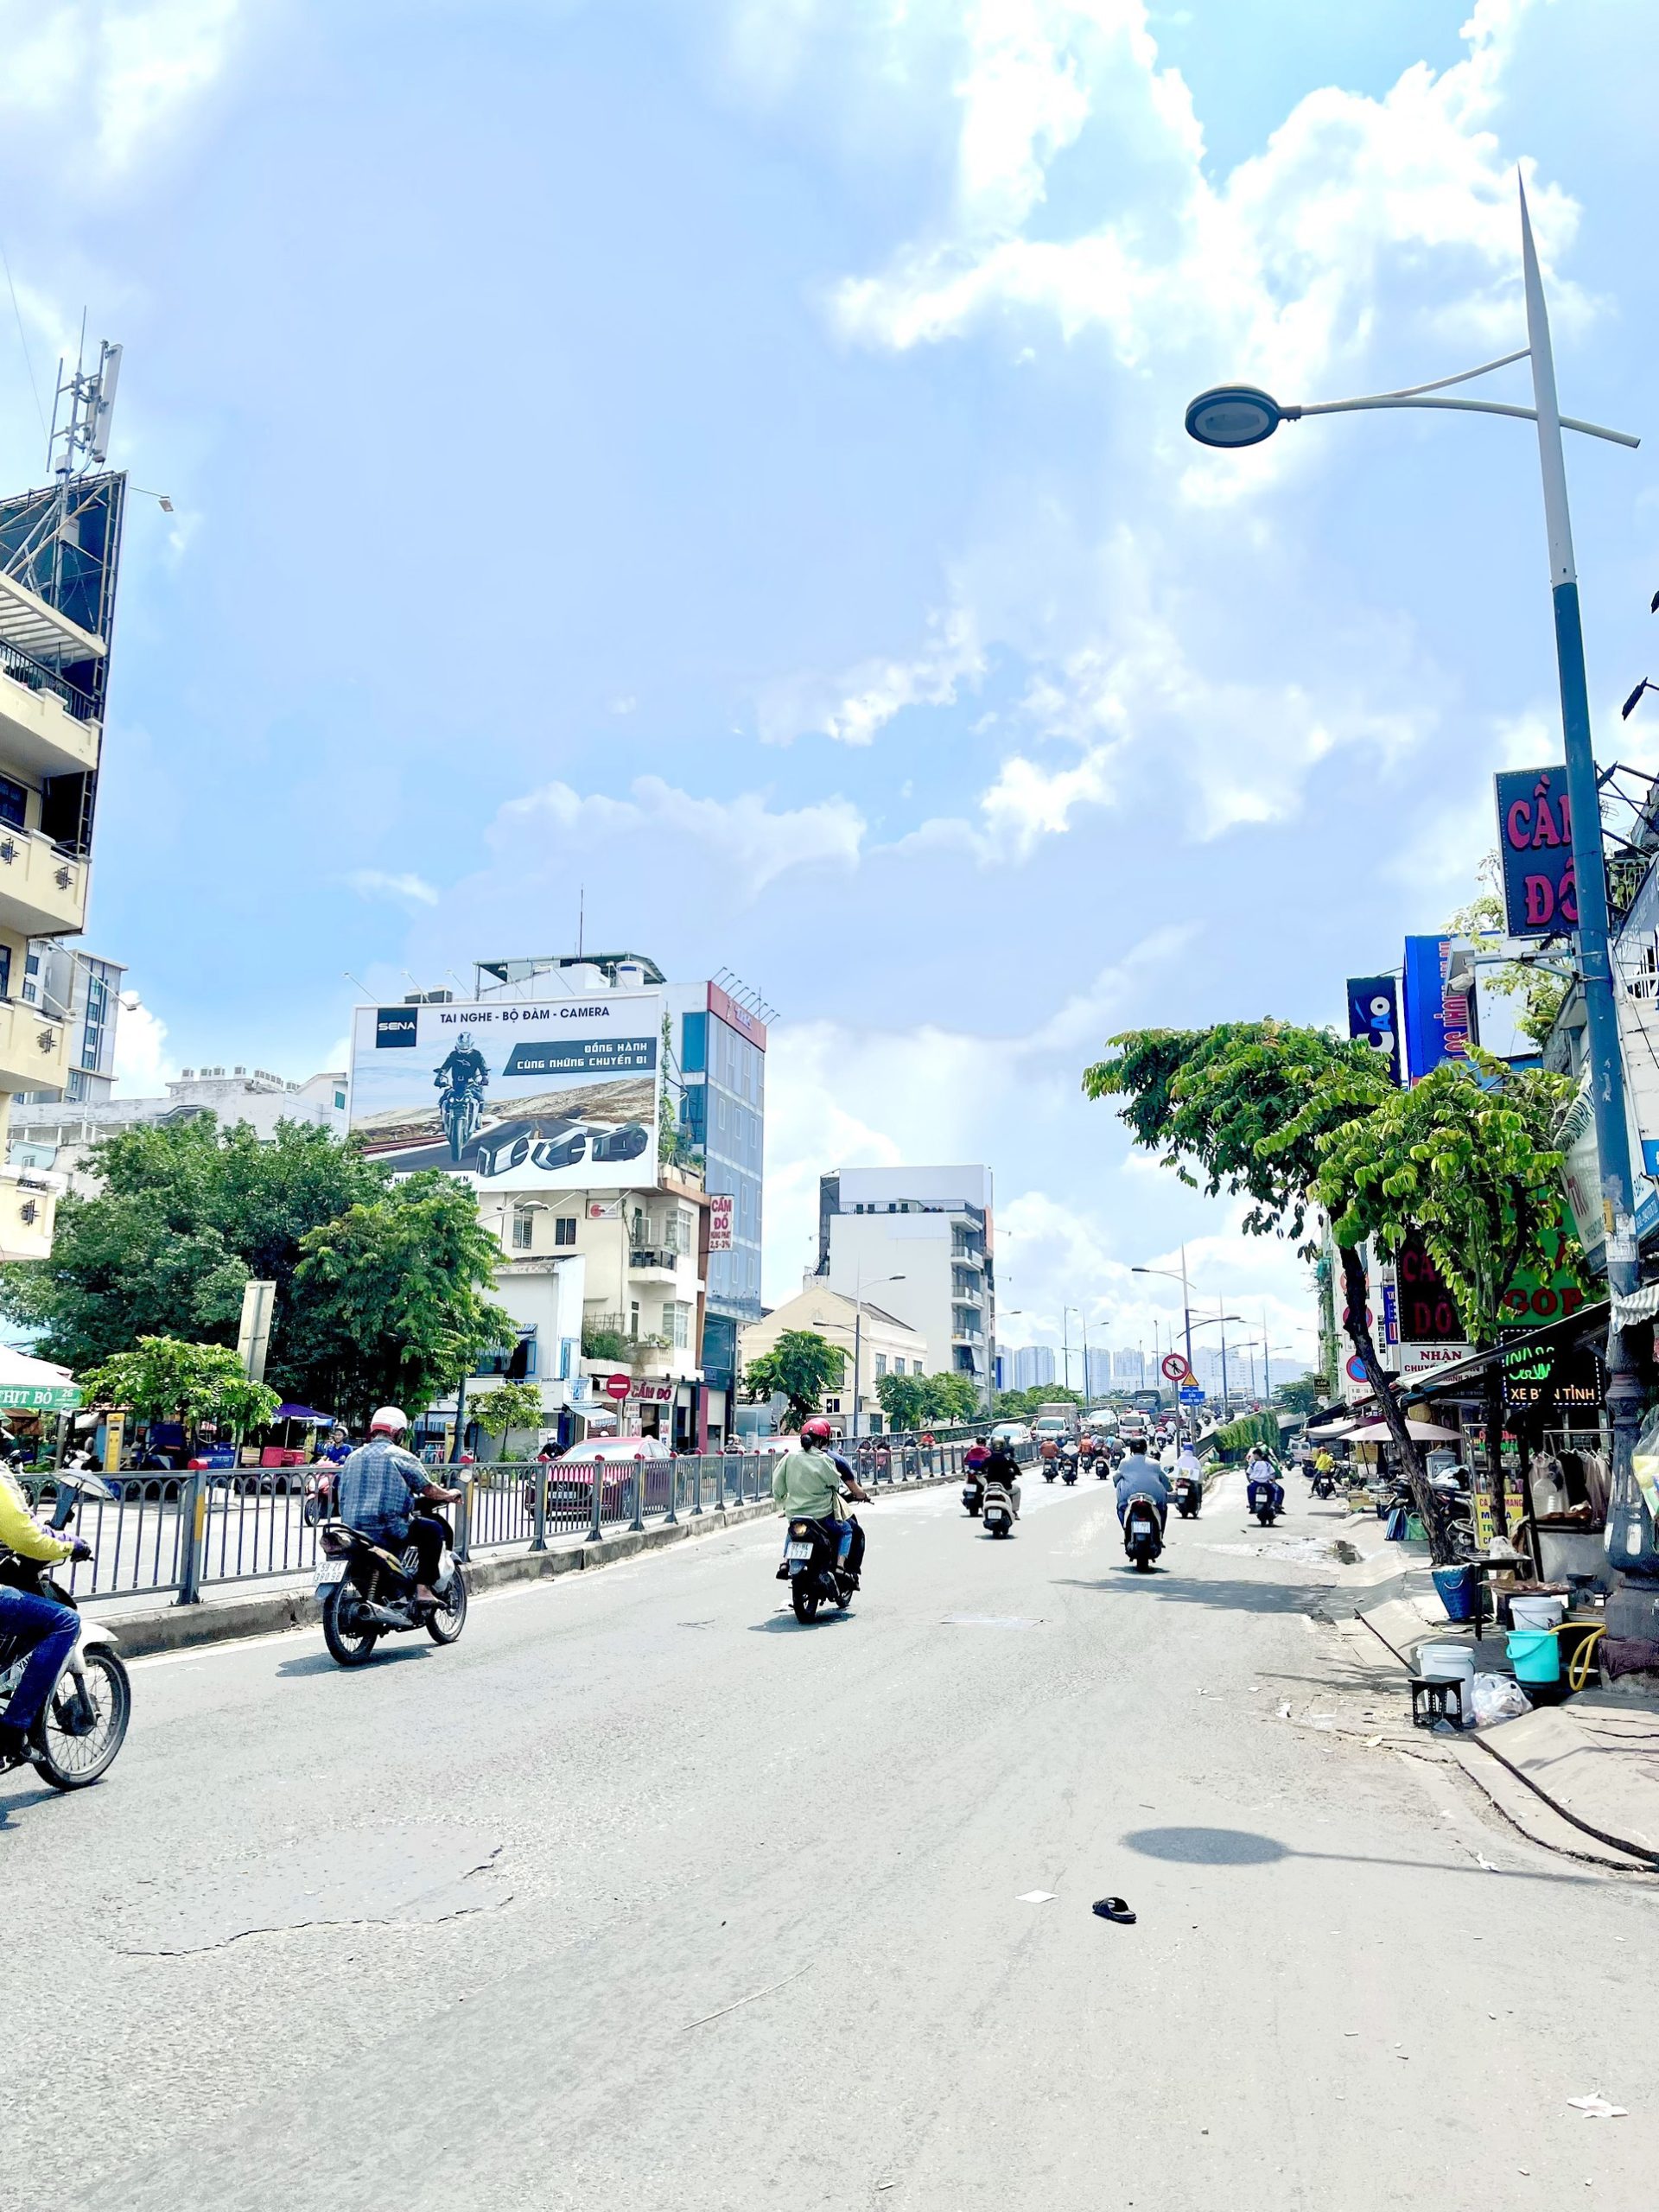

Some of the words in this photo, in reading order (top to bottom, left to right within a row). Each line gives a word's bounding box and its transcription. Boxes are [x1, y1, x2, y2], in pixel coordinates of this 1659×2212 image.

[441, 1014, 456, 1023] TAI
[461, 1012, 492, 1023] NGHE
[503, 1008, 518, 1023] BỘ
[523, 1007, 550, 1020] ĐÀM
[560, 1007, 610, 1019] CAMERA
[378, 1021, 416, 1031] SENA
[618, 1041, 647, 1052] HÀNH
[517, 1059, 545, 1070] CÙNG
[550, 1057, 585, 1068] NHỮNG
[589, 1054, 632, 1066] CHUYẾN
[1420, 1349, 1462, 1363] NHẬN
[33, 1388, 53, 1405] BÒ
[1510, 1388, 1527, 1400] XE
